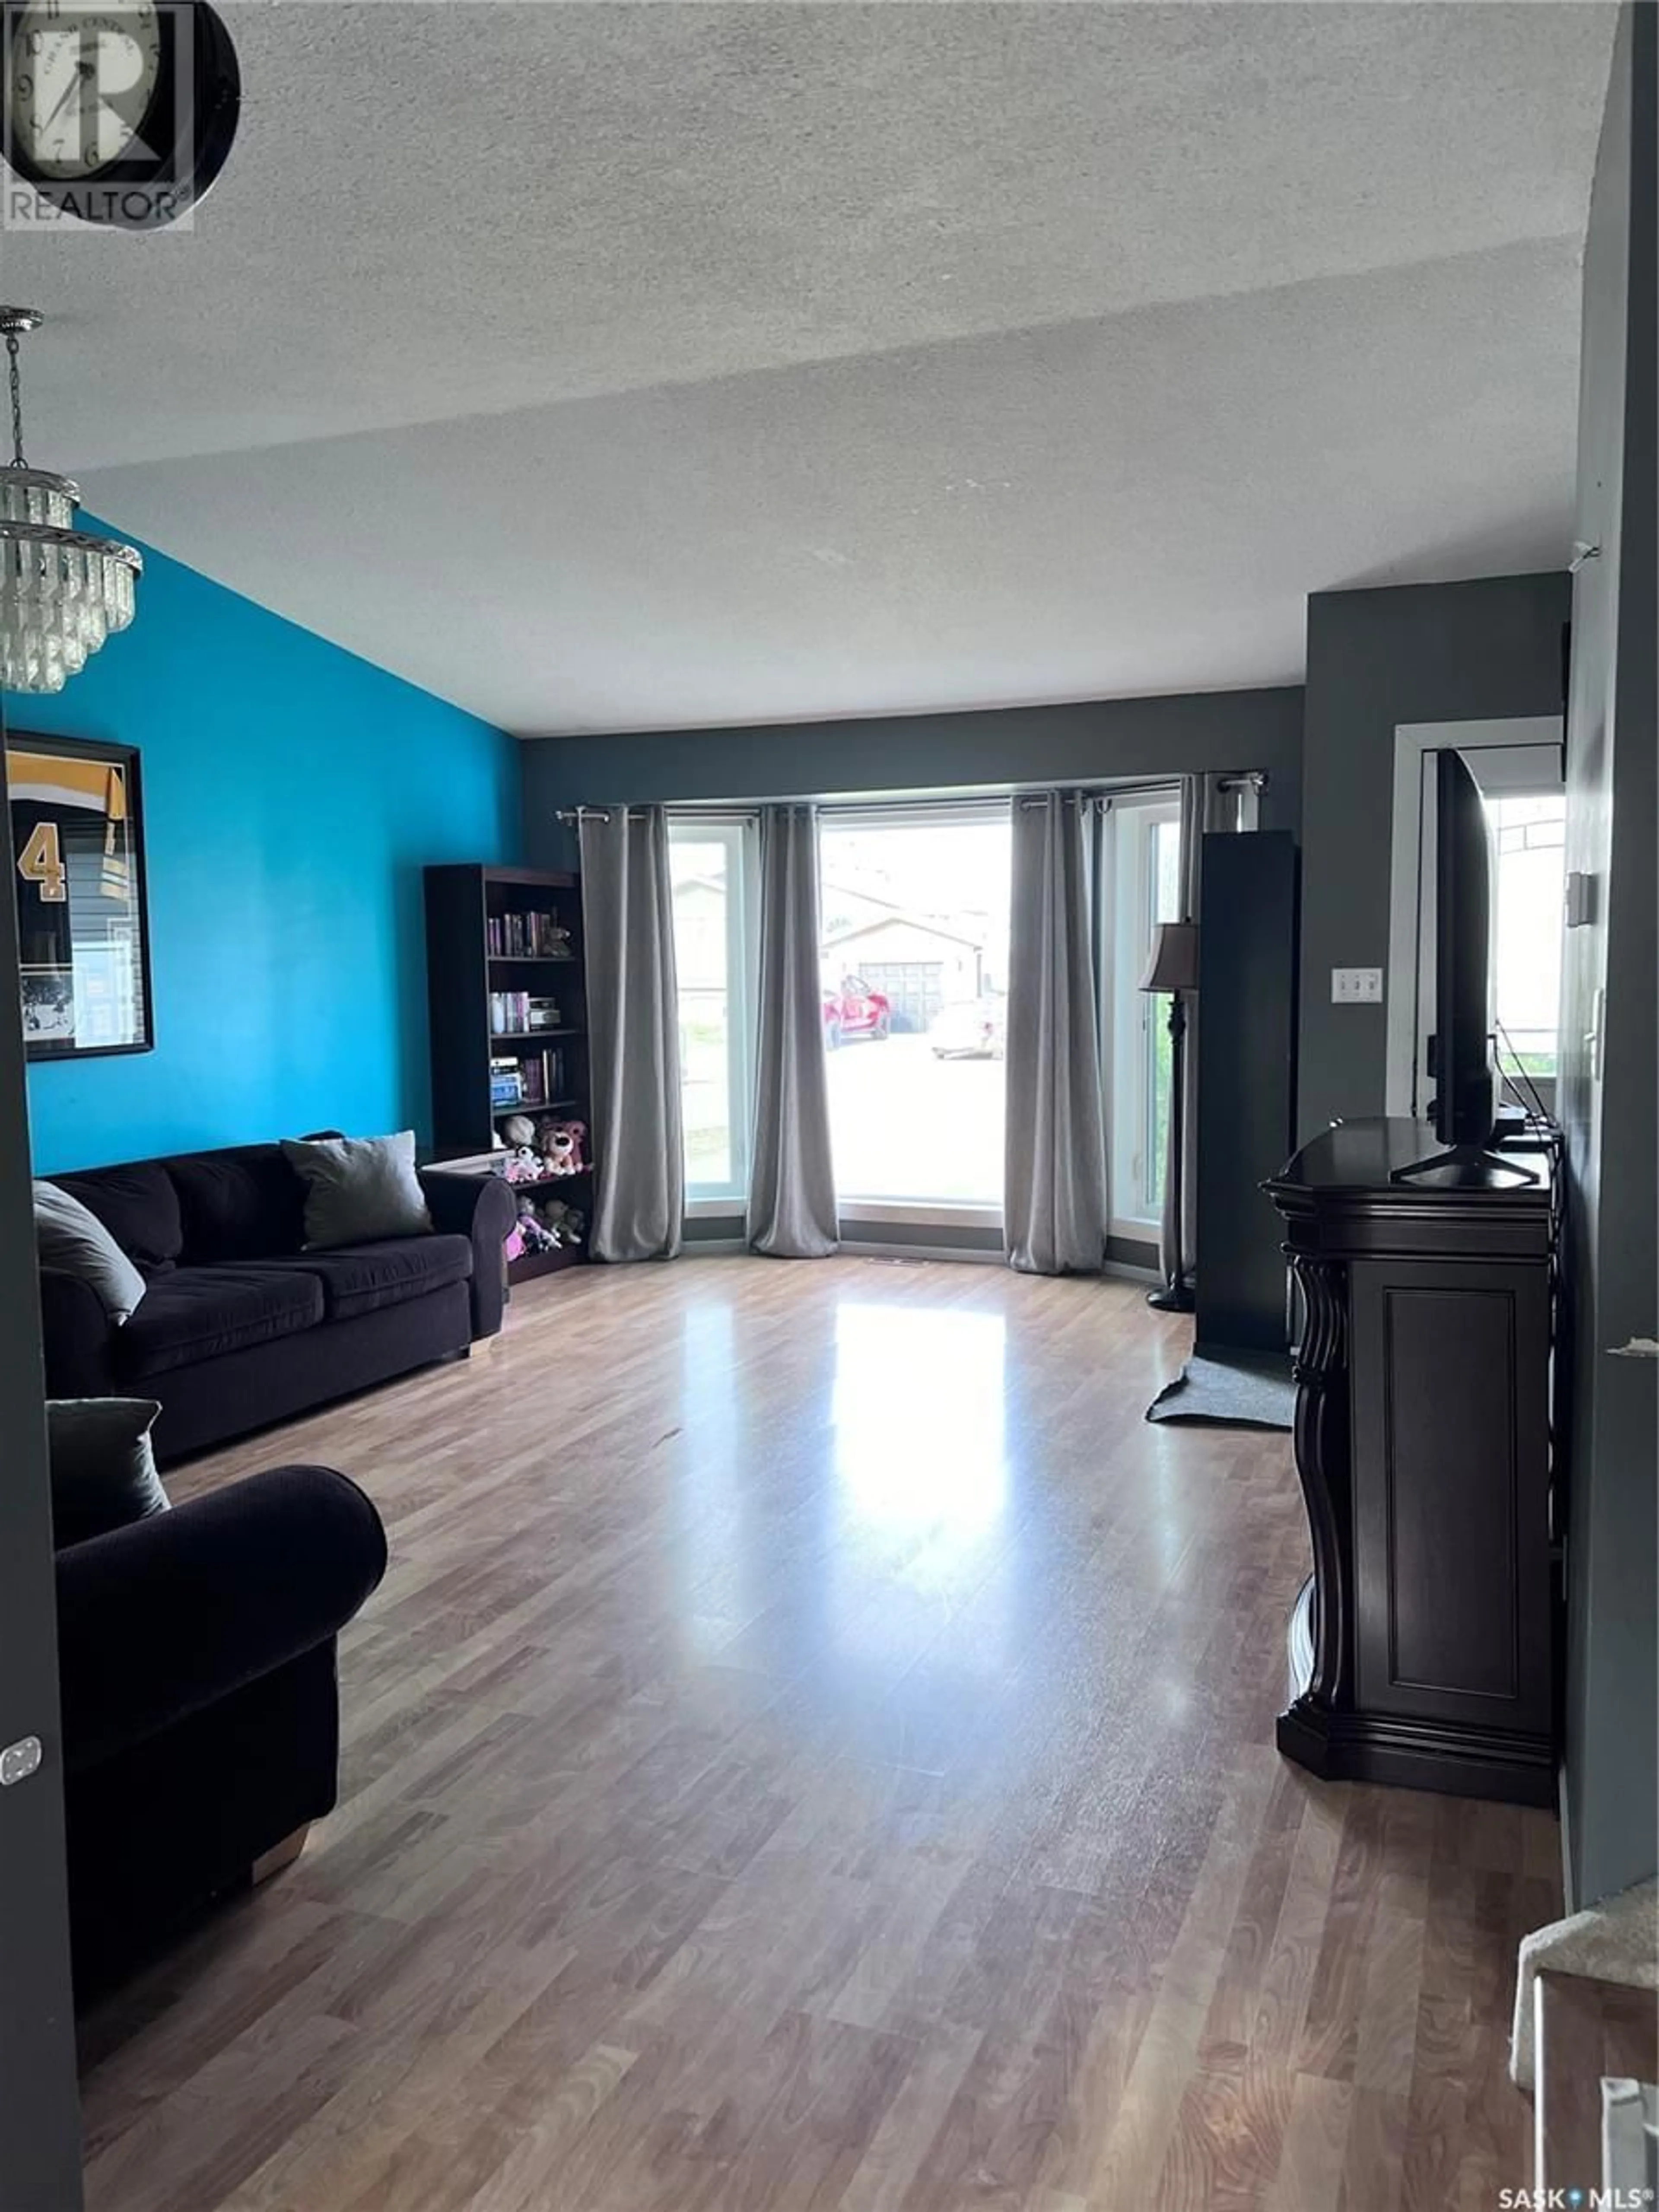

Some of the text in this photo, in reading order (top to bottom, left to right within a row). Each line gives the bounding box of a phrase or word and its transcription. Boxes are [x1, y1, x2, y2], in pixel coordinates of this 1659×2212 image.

[25, 29, 45, 58] 10
[16, 73, 34, 102] 9
[52, 138, 65, 165] 7
[84, 140, 100, 168] 6
[17, 822, 66, 902] 4
